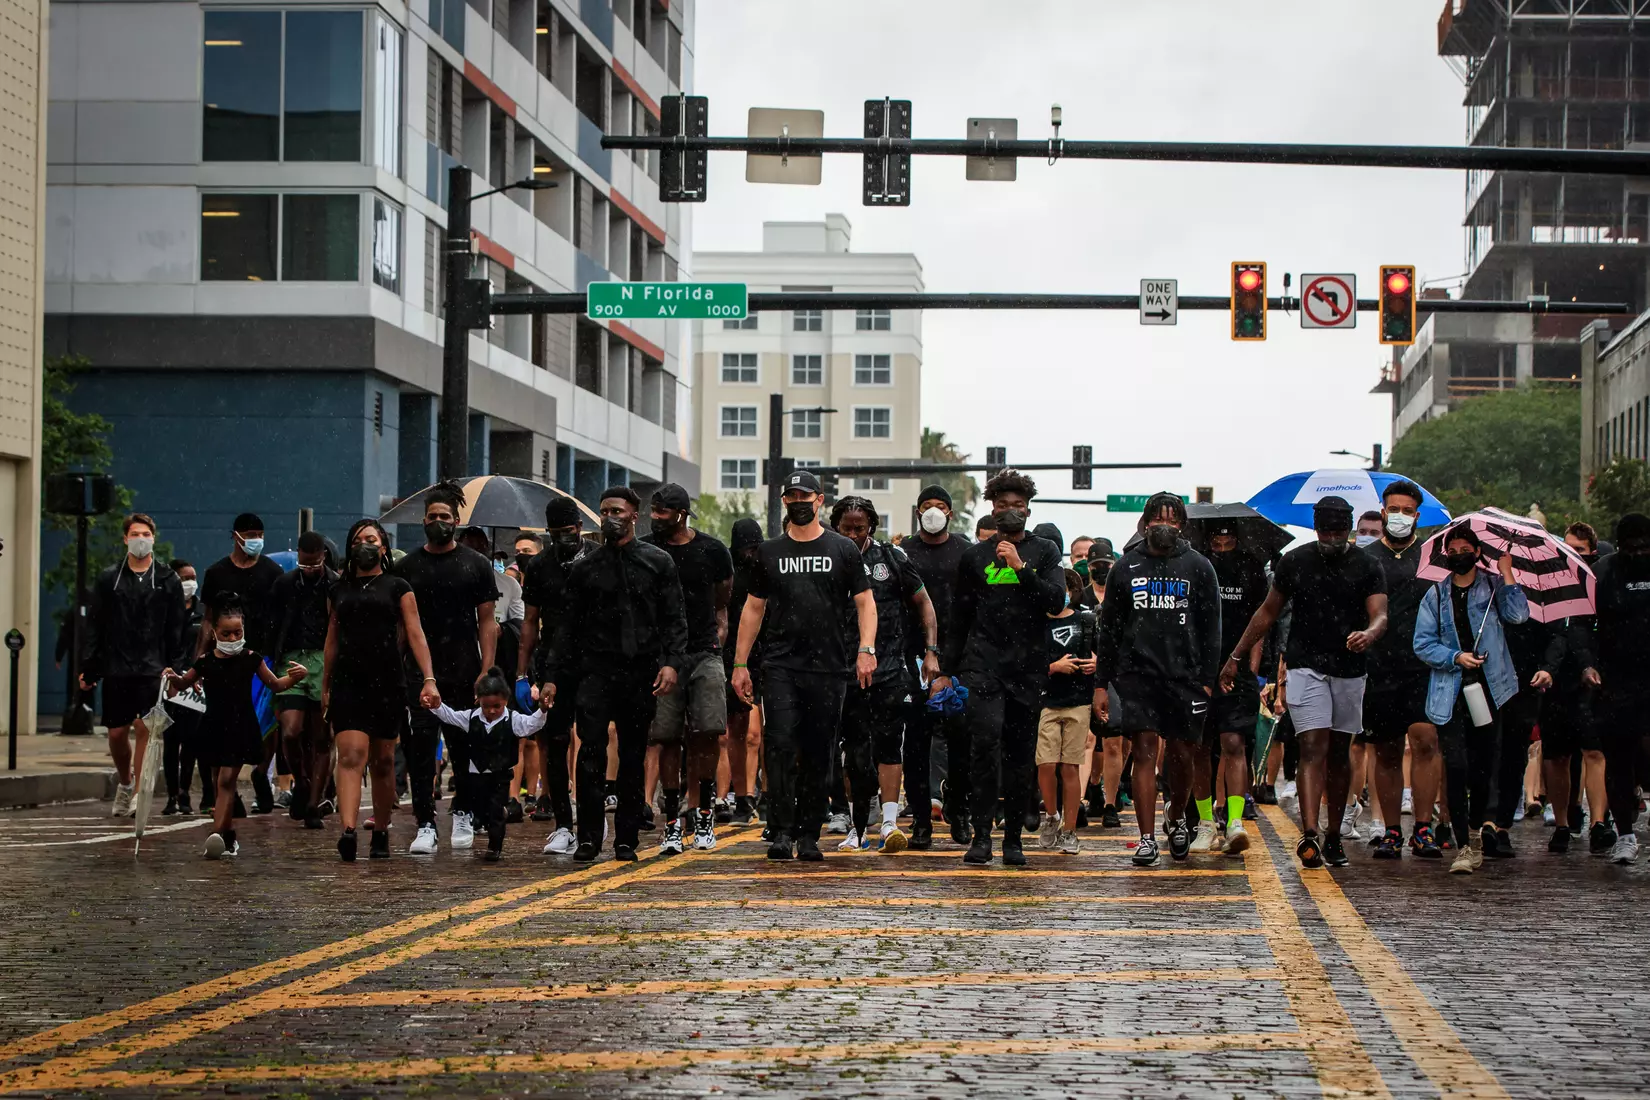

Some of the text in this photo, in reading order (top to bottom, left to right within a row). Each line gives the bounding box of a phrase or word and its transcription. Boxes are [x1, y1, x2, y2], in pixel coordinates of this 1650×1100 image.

[621, 286, 714, 300] N Florida
[1147, 282, 1171, 293] ONE
[1146, 295, 1171, 306] WAY
[594, 305, 741, 316] 900 AV 1000
[1316, 484, 1362, 492] imethods
[778, 556, 833, 574] UNITED
[1131, 577, 1148, 610] 2018
[1150, 594, 1176, 609] CLASS
[1179, 612, 1187, 625] 3
